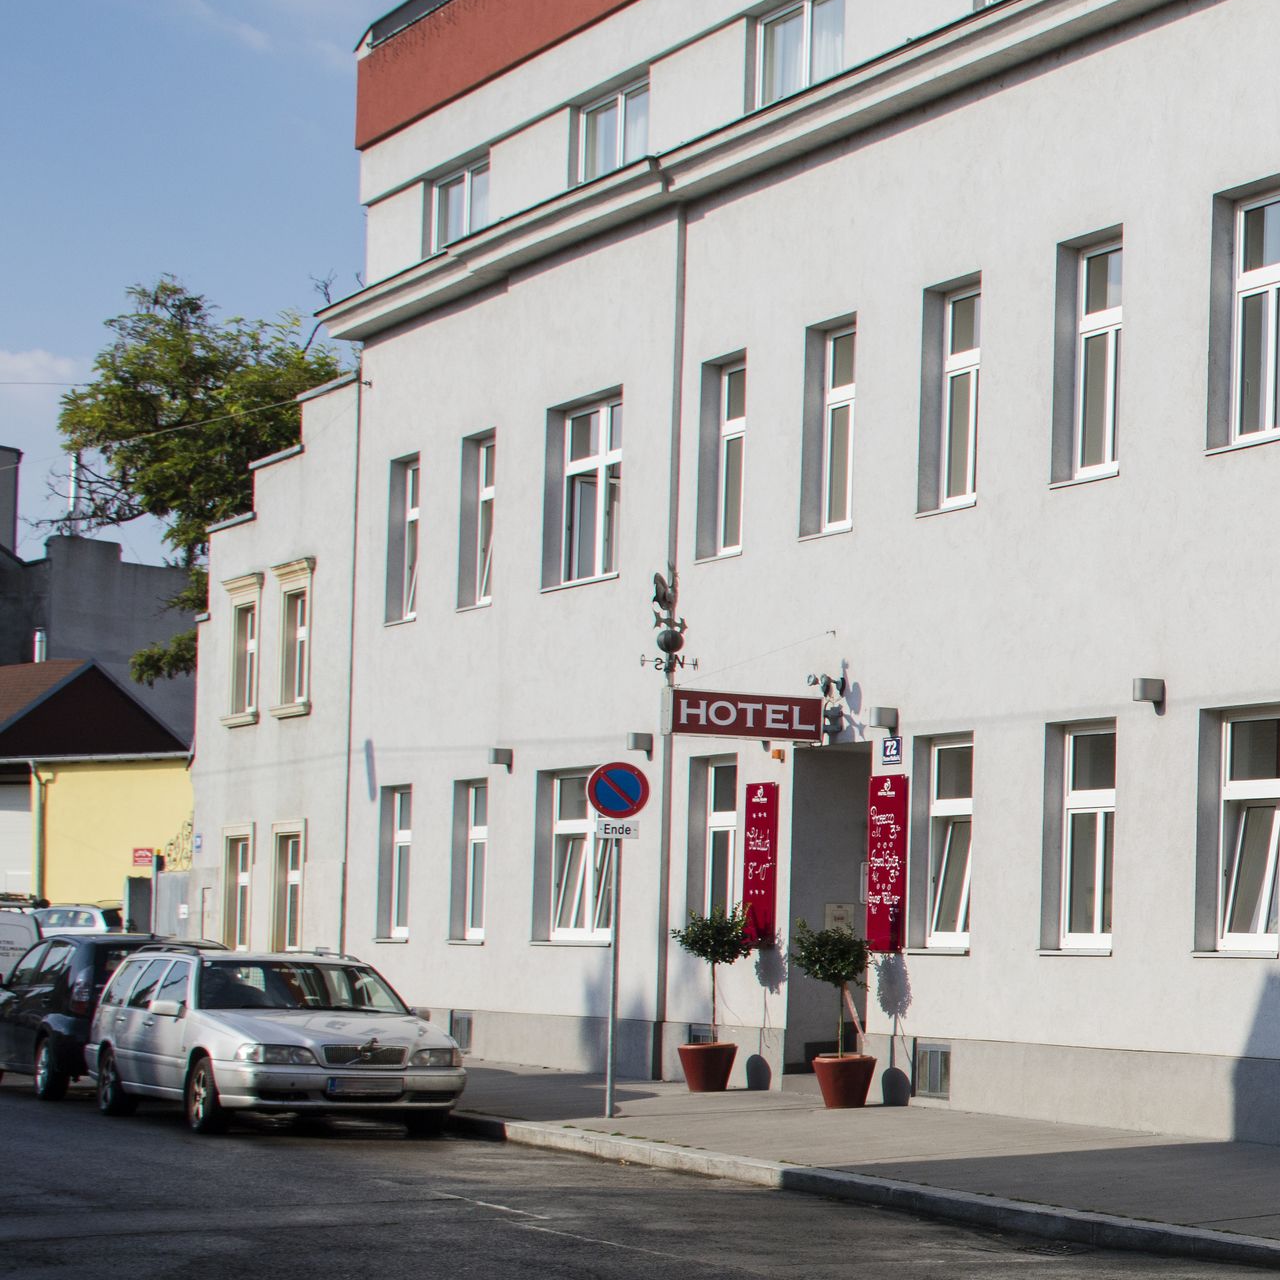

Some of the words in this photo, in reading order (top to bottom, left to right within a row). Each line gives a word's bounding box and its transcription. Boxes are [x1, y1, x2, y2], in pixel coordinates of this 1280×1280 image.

[679, 698, 816, 732] HOTEL
[884, 740, 898, 756] 72
[603, 823, 632, 835] Ende
